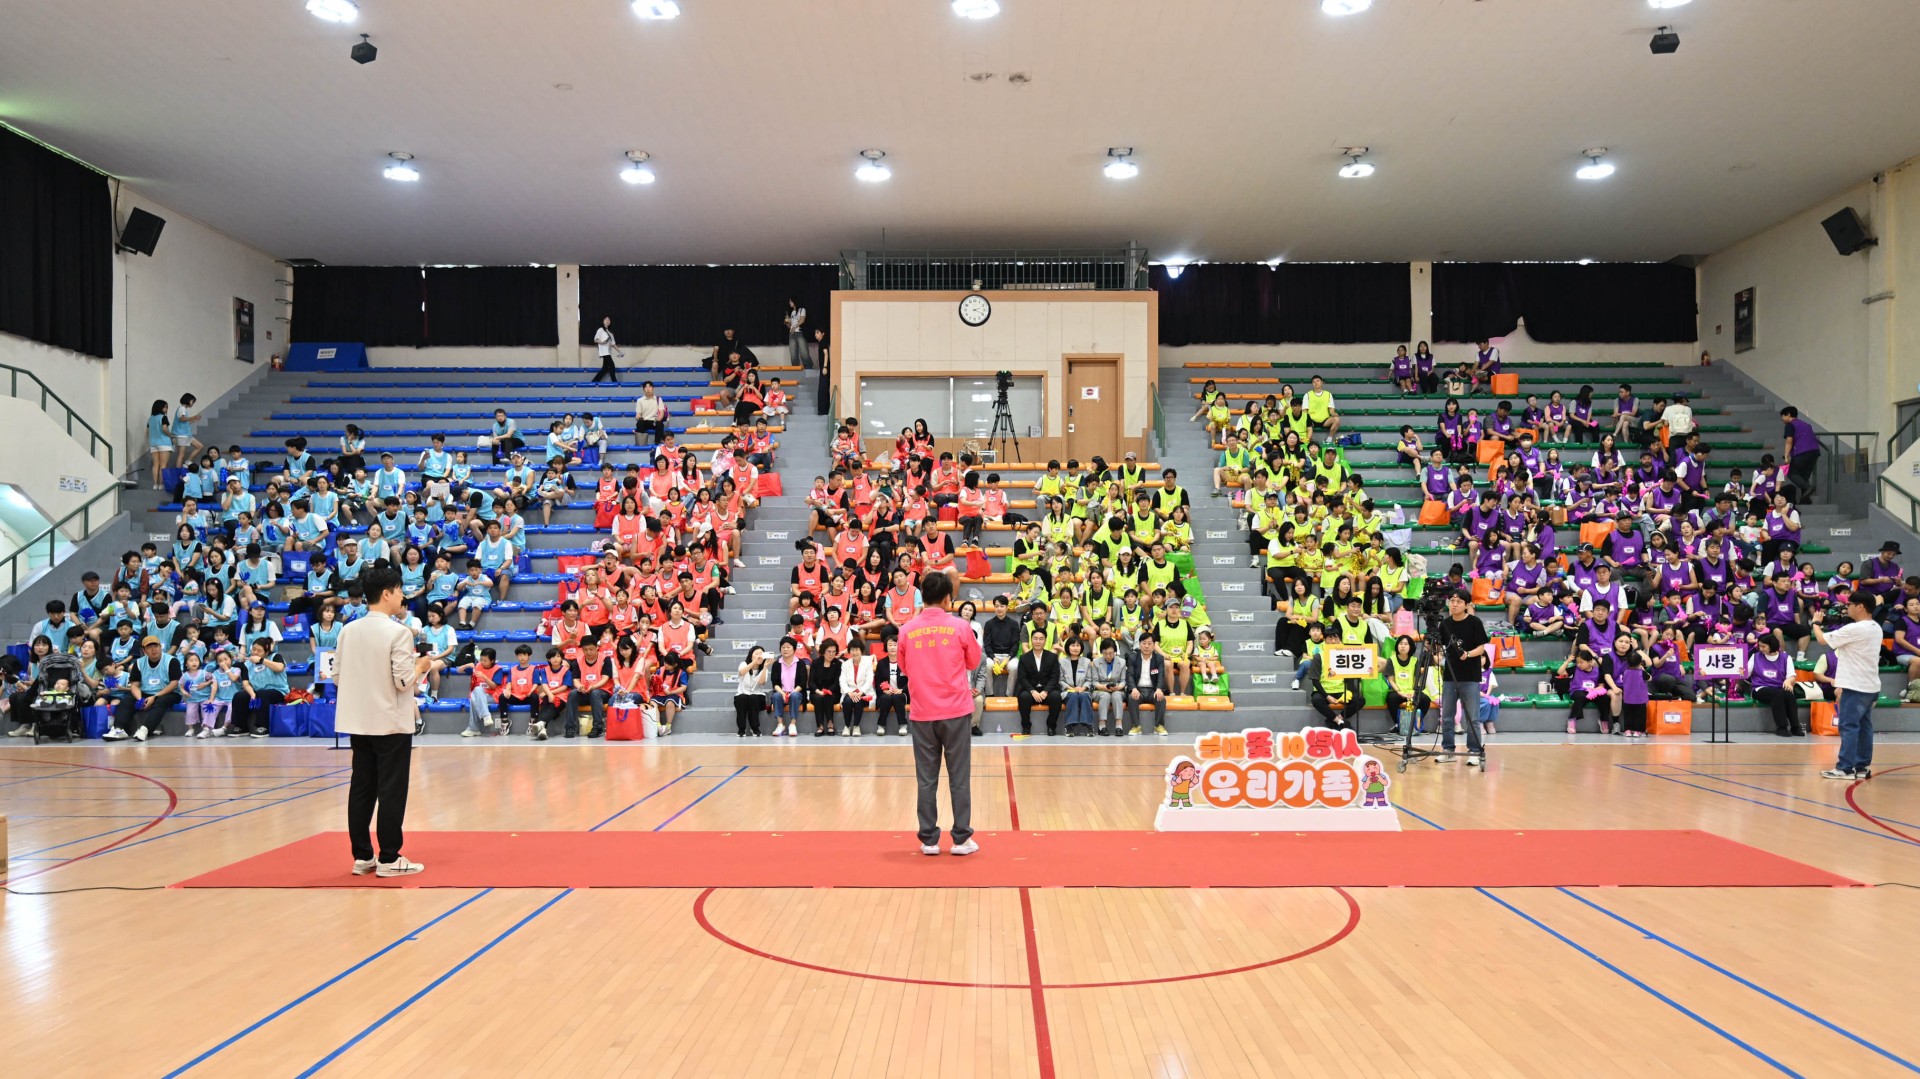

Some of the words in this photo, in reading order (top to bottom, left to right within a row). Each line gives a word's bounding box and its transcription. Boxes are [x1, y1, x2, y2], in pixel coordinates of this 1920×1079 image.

[1335, 654, 1366, 669] 희망
[1705, 654, 1736, 669] 사랑
[1208, 769, 1353, 801] 우리가족
